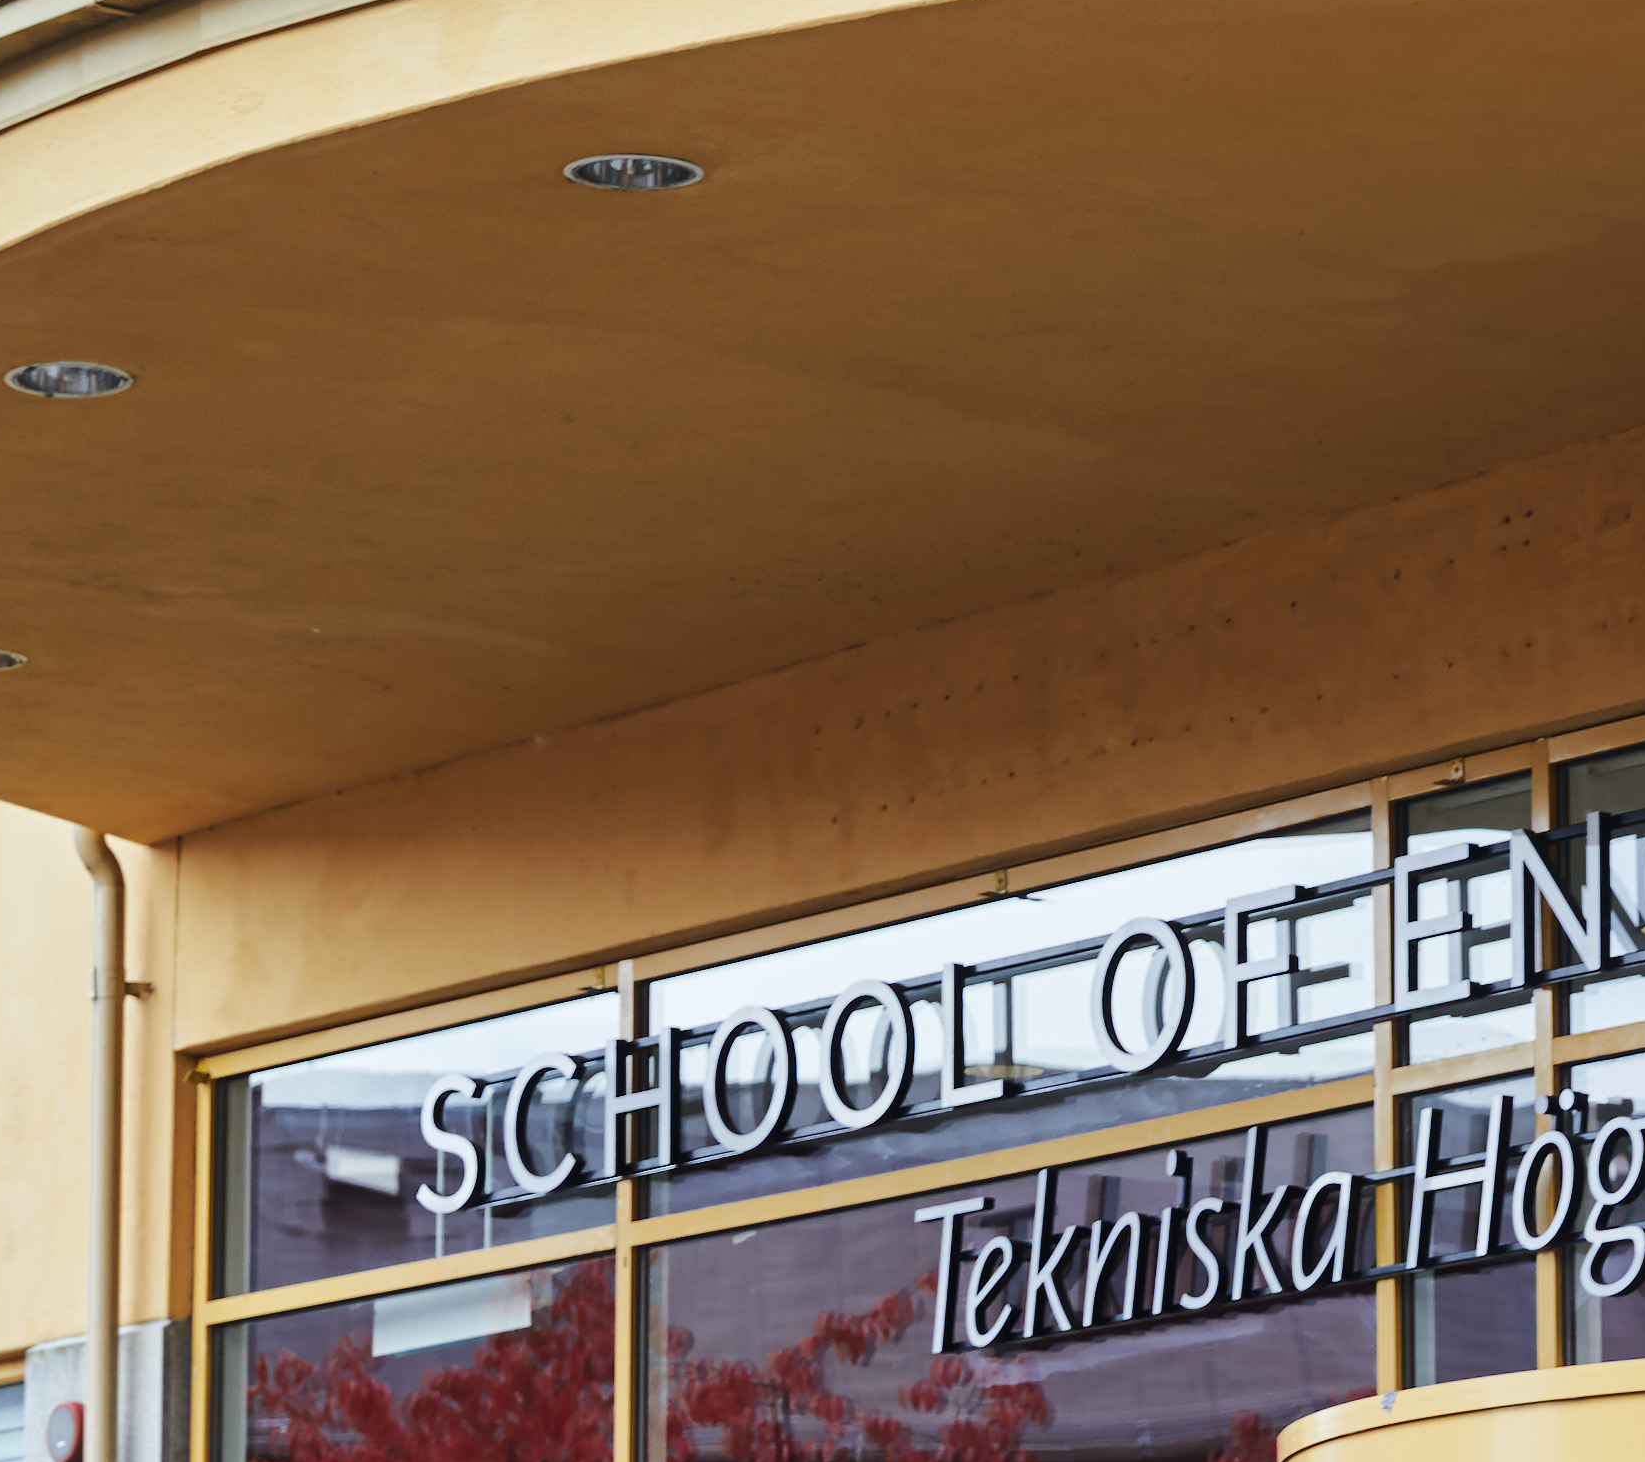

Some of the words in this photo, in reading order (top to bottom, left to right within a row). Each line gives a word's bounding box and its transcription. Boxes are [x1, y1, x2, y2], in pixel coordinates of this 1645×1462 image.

[416, 963, 1006, 1215] SCHOOL
[1091, 883, 1304, 1074] OF
[914, 1127, 1353, 1355] Tekniska
